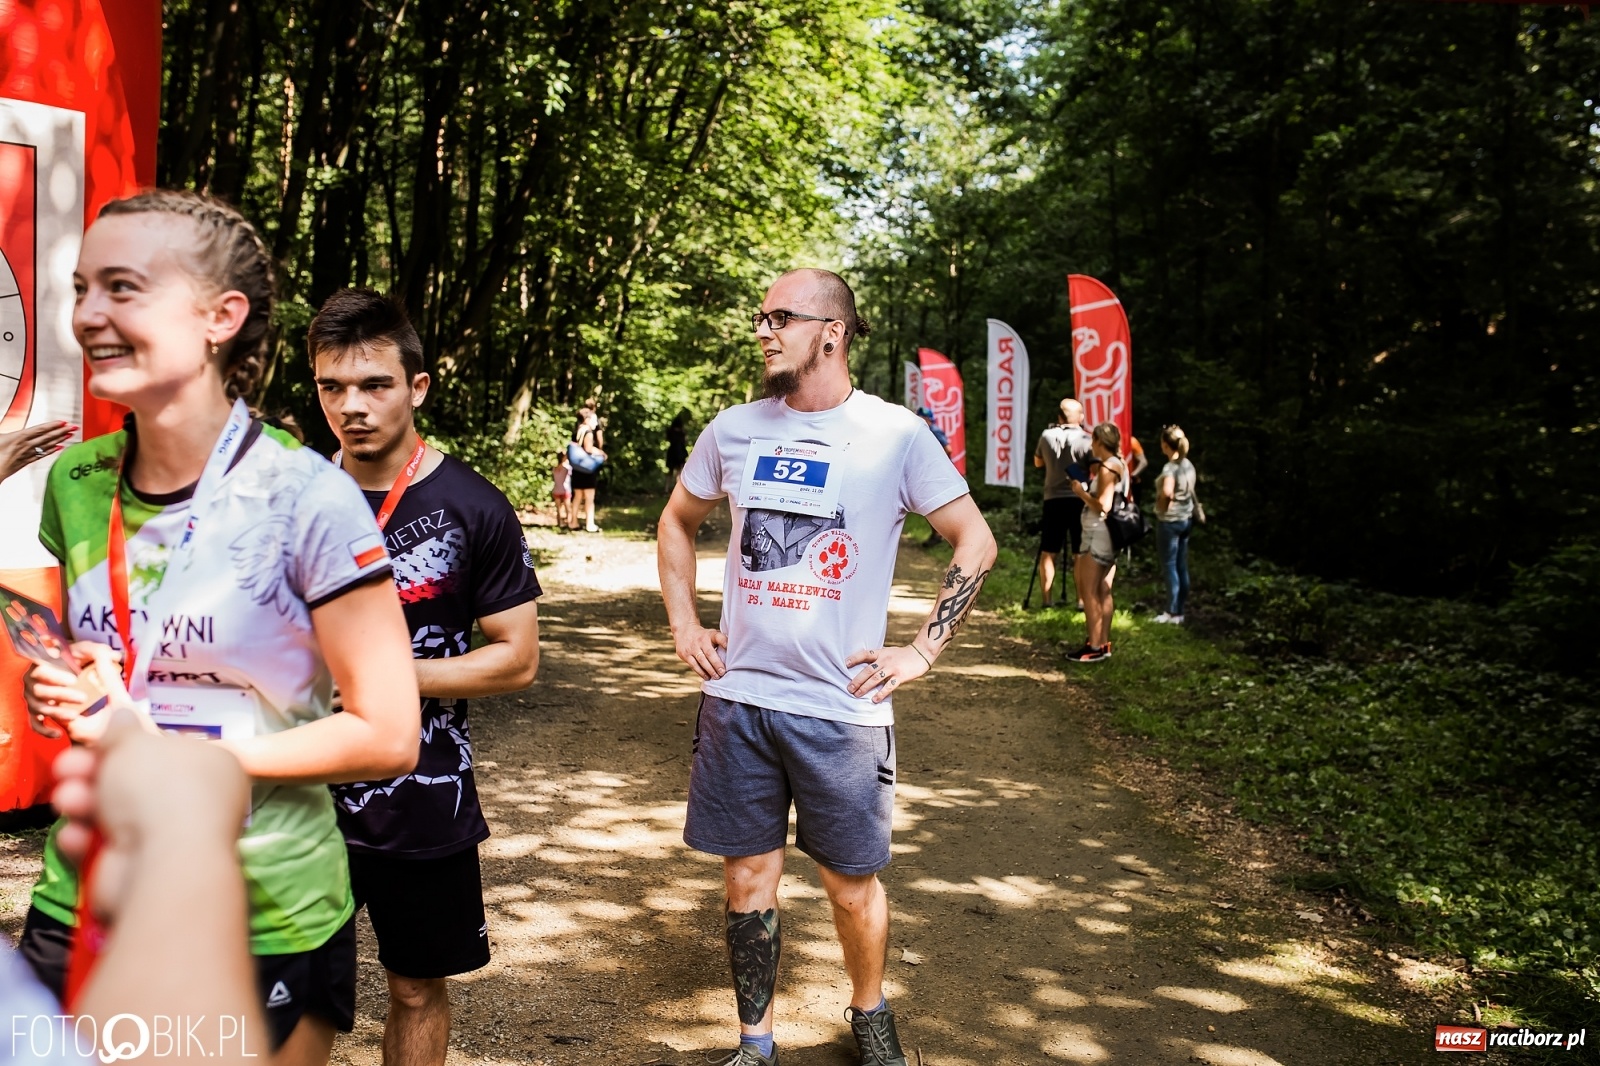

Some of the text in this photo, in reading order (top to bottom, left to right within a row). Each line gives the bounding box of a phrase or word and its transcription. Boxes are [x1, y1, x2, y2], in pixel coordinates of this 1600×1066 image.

[773, 460, 807, 482] 52
[767, 581, 841, 601] MARKIEWICZ
[748, 594, 810, 611] PS. MARYL
[78, 604, 213, 643] AKWNI
[109, 635, 187, 659] LKI
